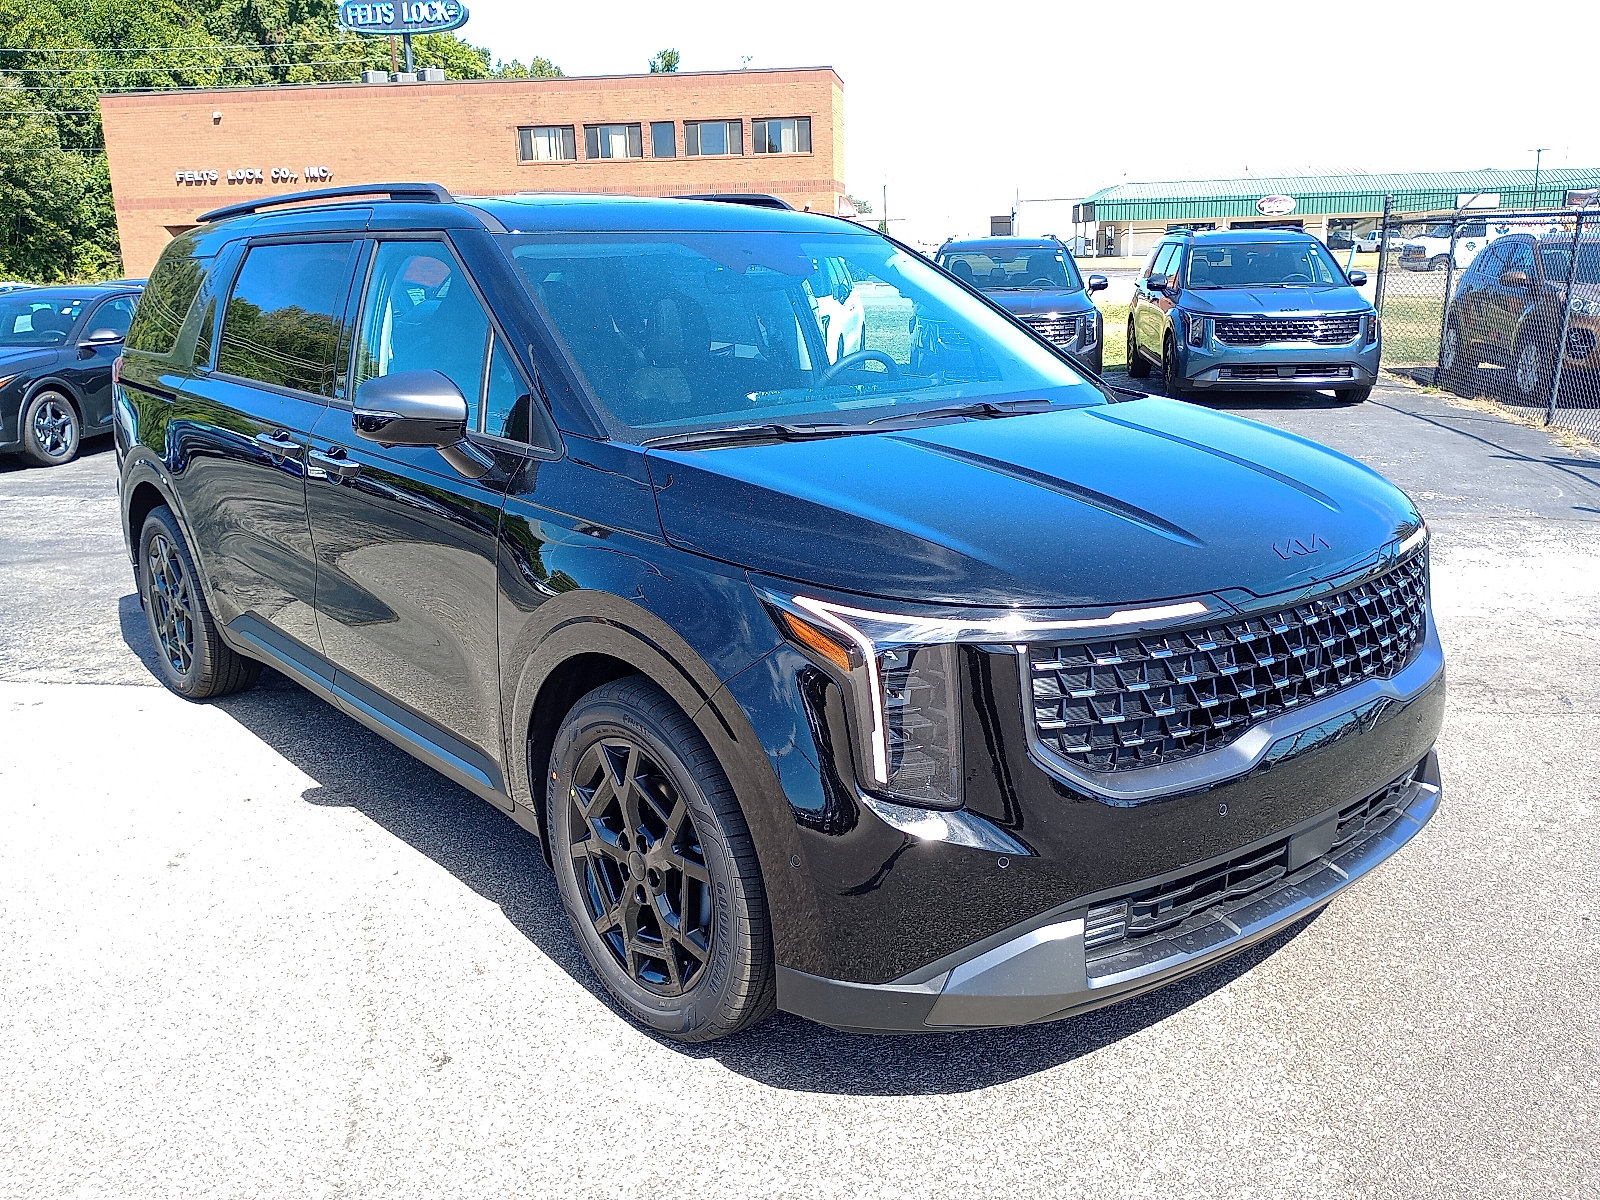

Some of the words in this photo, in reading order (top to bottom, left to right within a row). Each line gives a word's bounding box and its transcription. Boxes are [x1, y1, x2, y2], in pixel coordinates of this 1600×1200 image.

[346, 2, 395, 25] FELTS
[401, 0, 450, 24] LOCK
[175, 169, 219, 184] FELTS
[226, 168, 264, 183] LOCK
[304, 165, 333, 181] INC.
[1272, 533, 1332, 560] KIA
